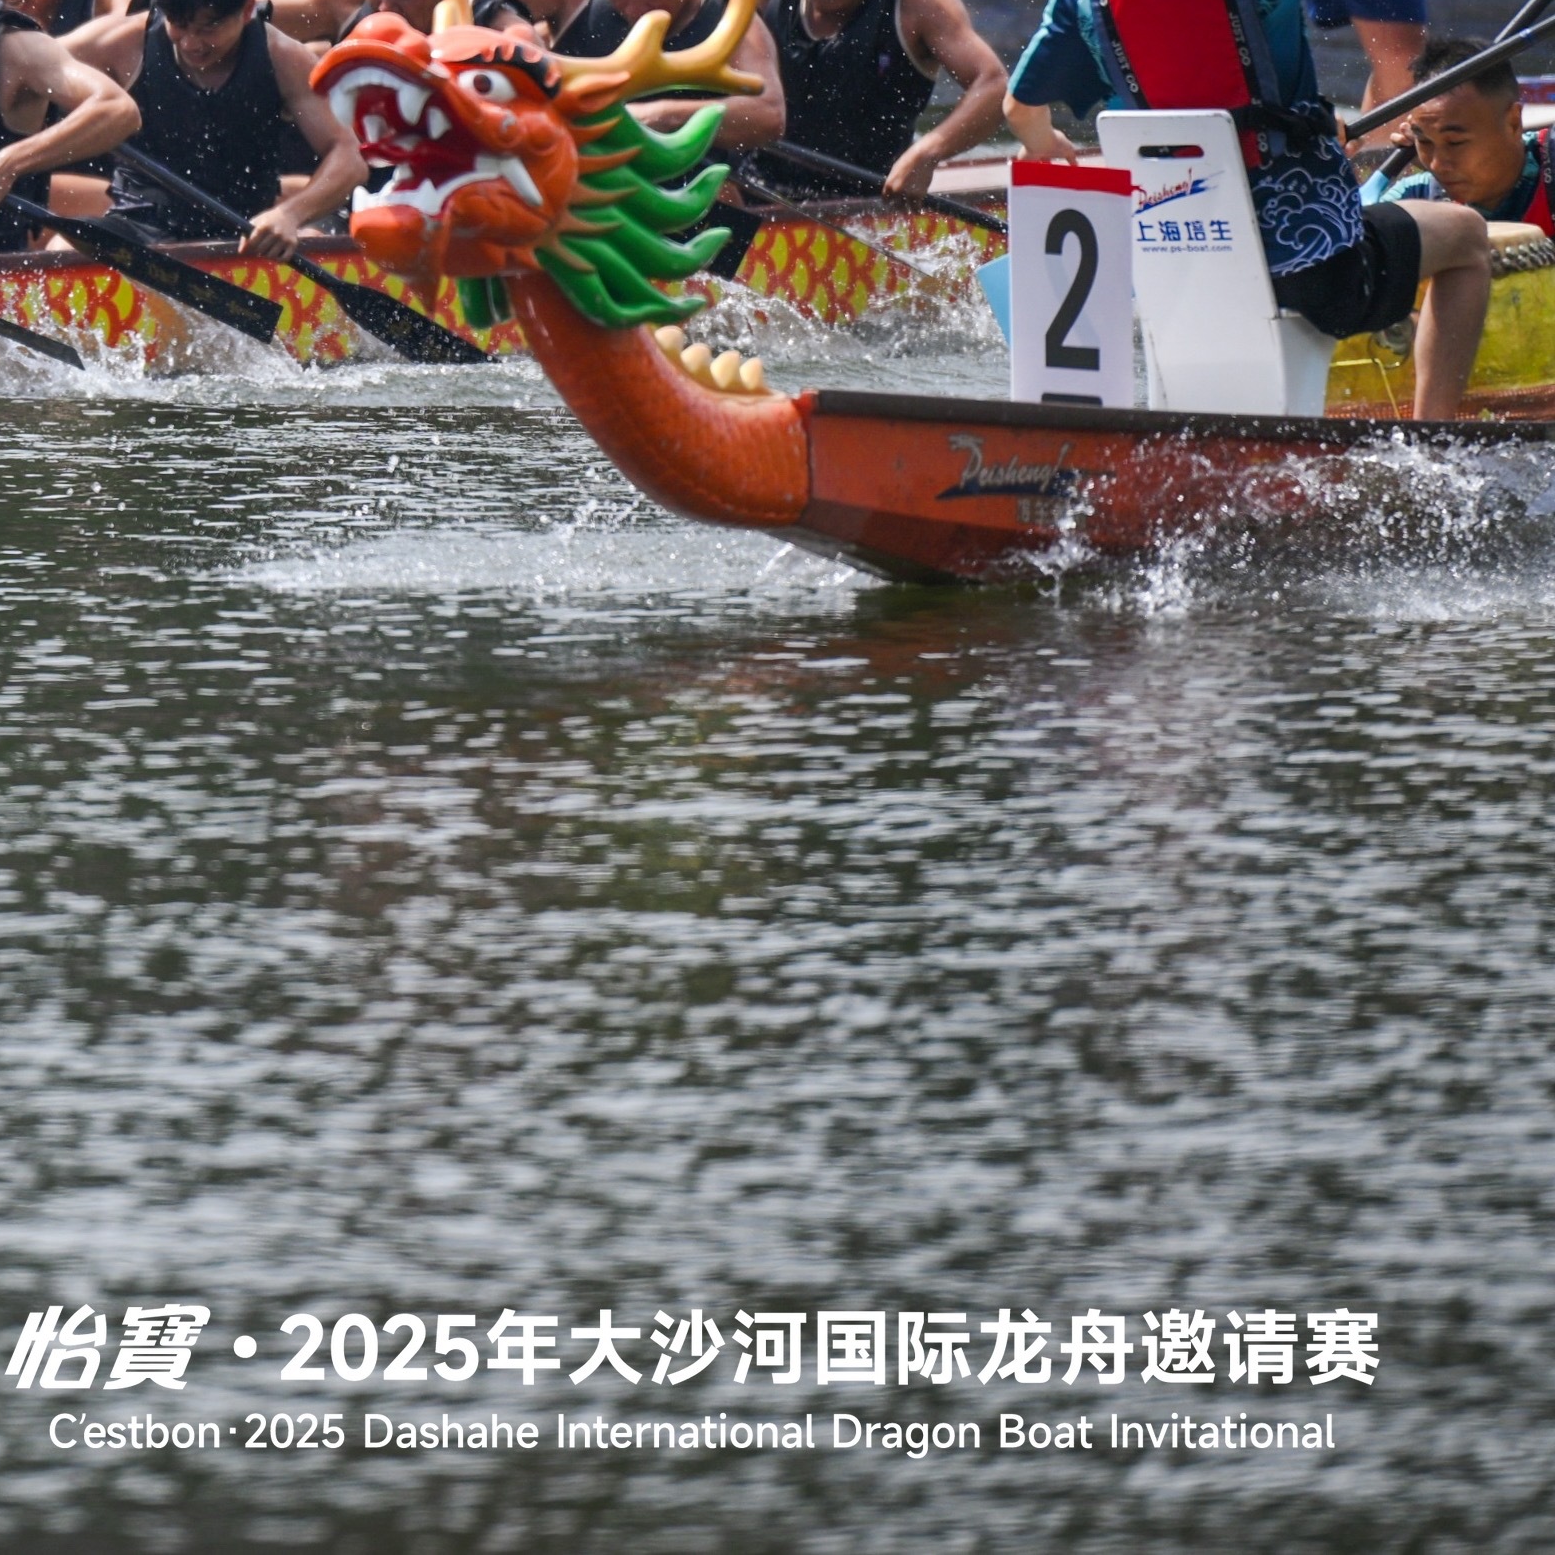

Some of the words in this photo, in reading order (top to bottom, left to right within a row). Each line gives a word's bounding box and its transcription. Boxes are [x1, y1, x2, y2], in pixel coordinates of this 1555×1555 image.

[1136, 220, 1233, 242] 上海培生
[1141, 244, 1233, 254] www.ps-boat.com
[1045, 208, 1100, 371] 2
